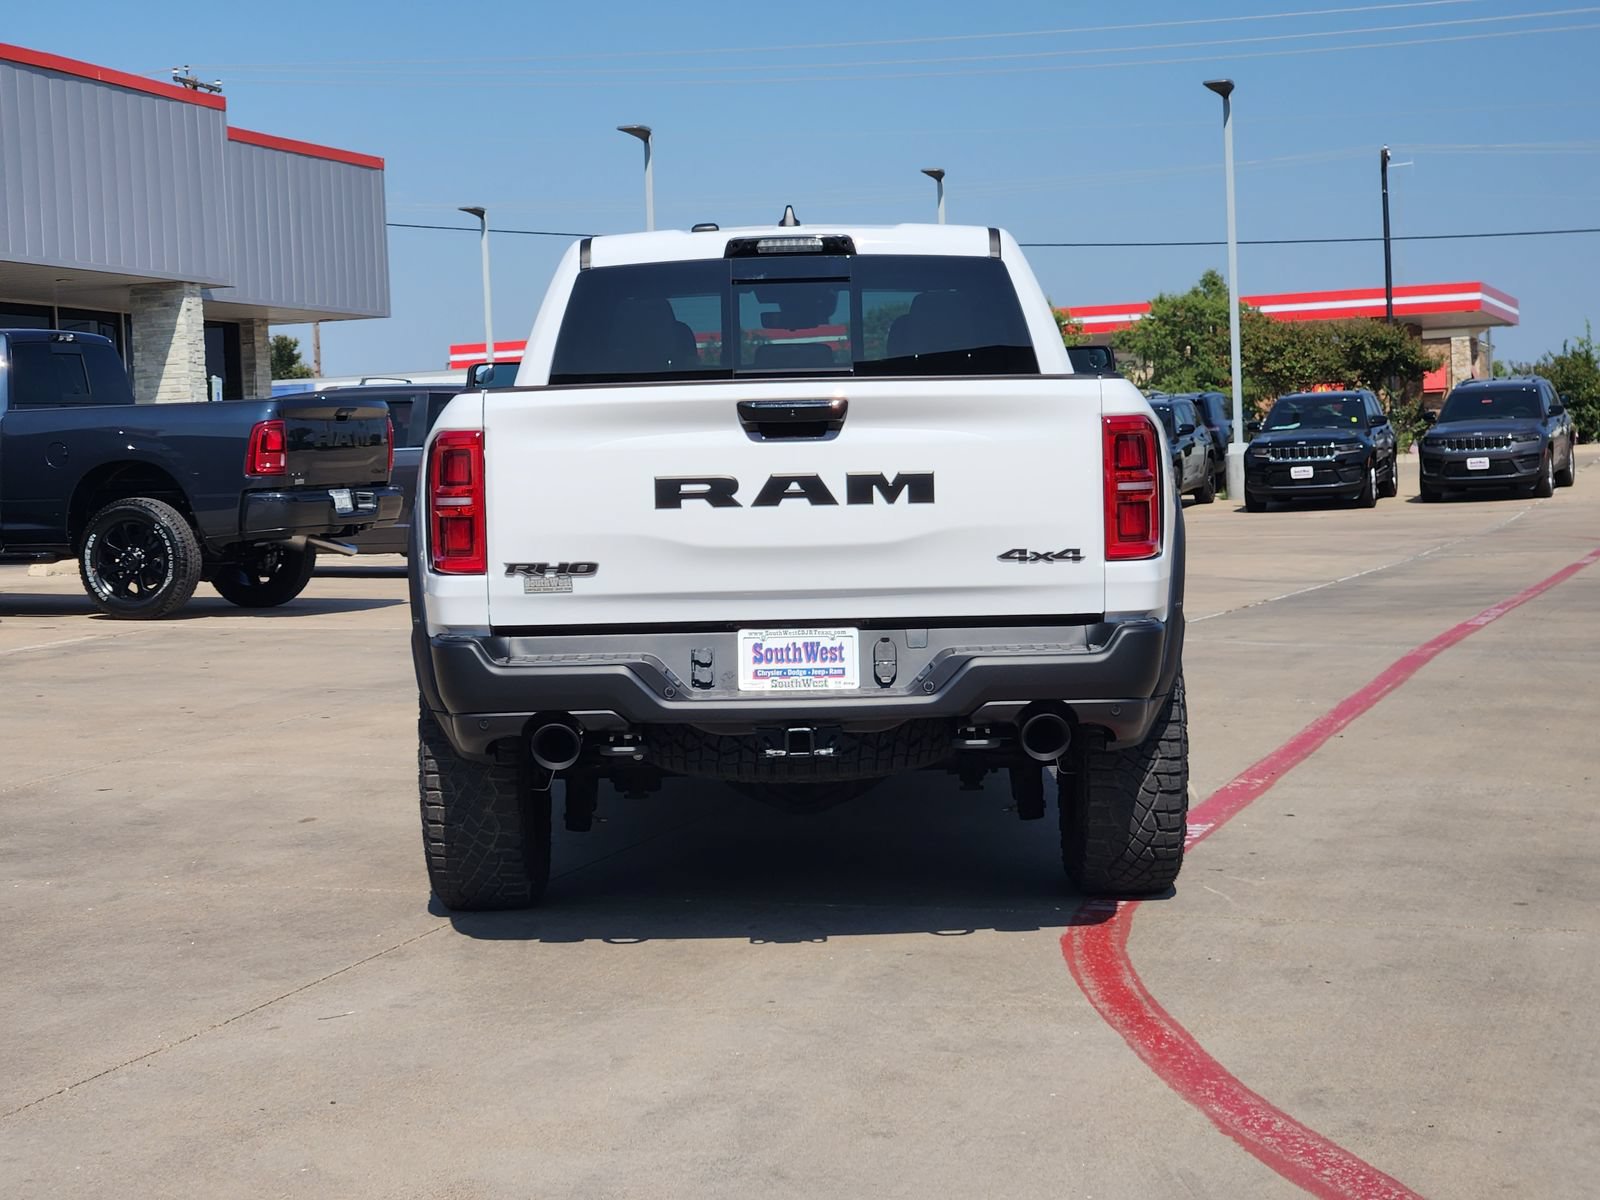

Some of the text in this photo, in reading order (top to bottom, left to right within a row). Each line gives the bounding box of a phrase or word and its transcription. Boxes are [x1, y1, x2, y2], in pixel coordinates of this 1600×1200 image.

[654, 470, 935, 509] RAM
[997, 548, 1086, 564] 4x4
[503, 562, 599, 578] RHO
[752, 640, 845, 664] SouthWest
[757, 669, 783, 677] Chrysler
[811, 668, 826, 676] Jeep
[770, 678, 829, 689] SouthWest
